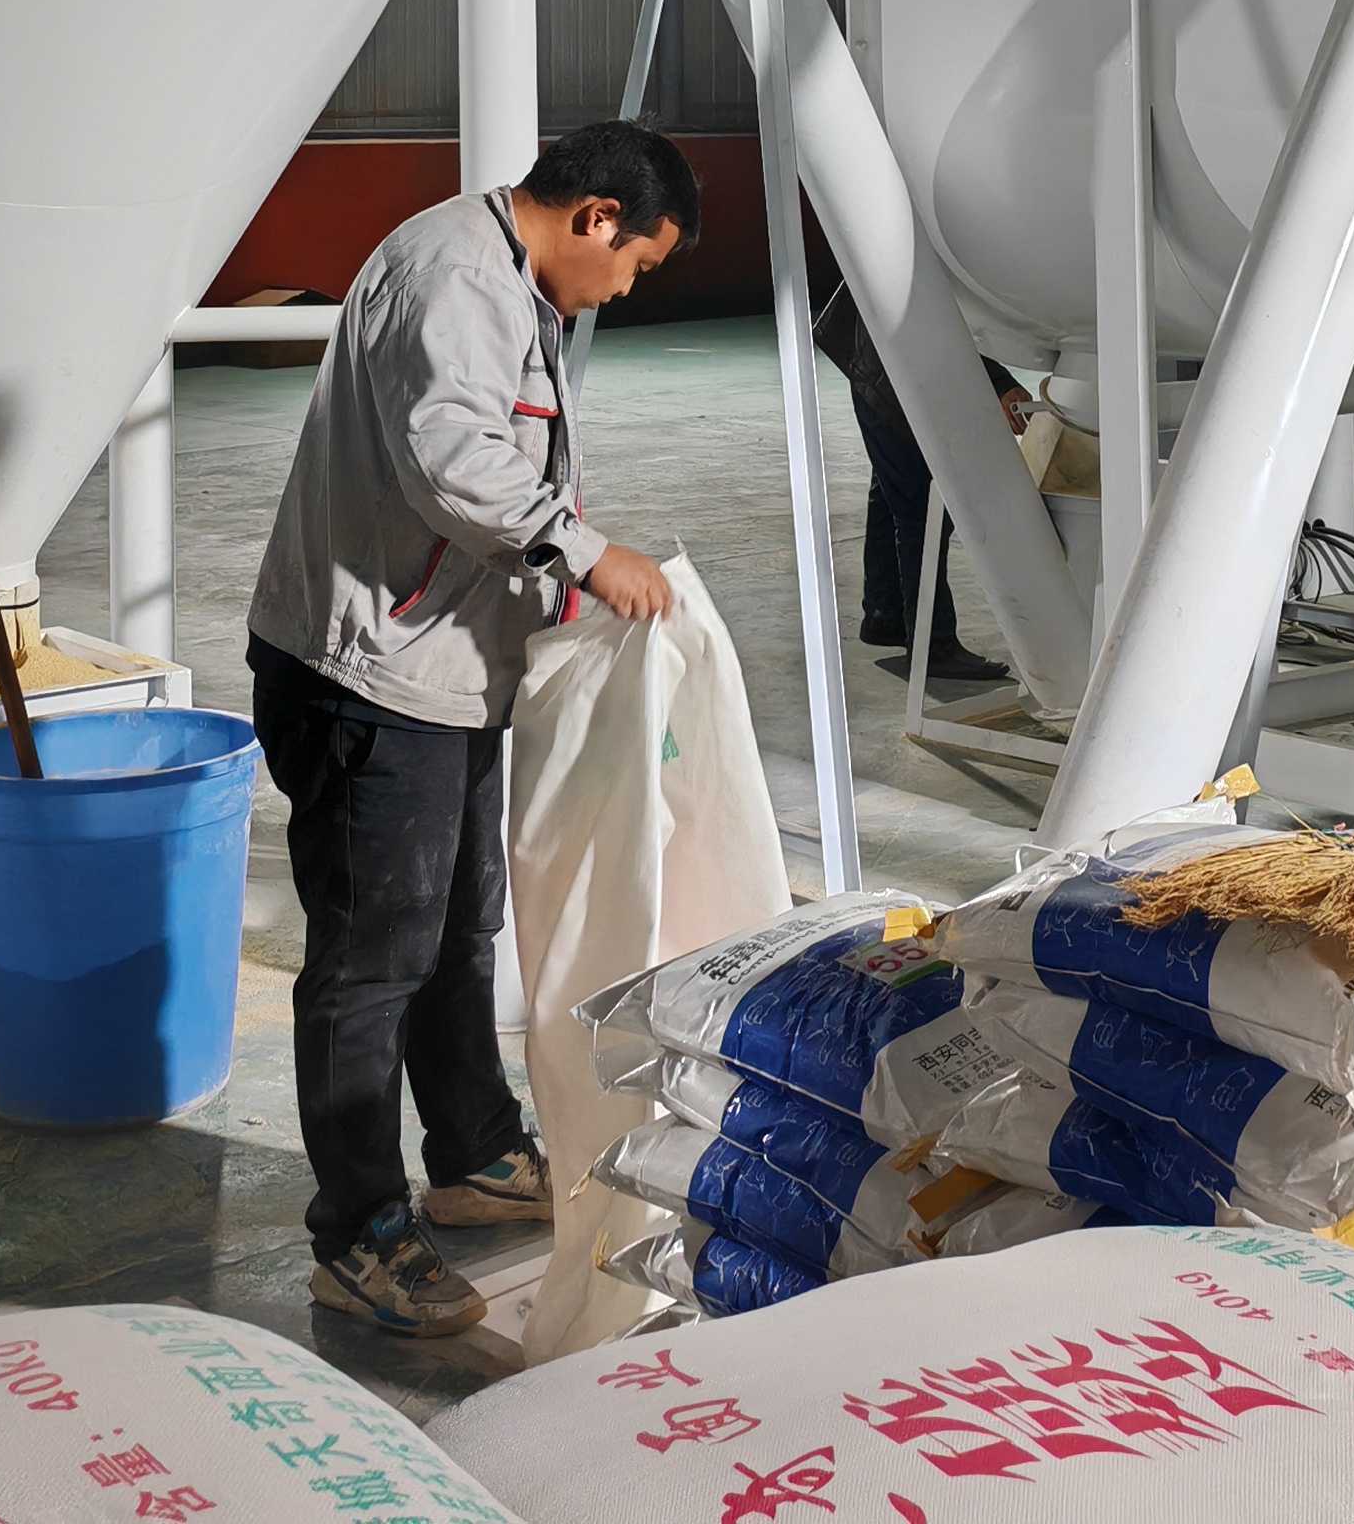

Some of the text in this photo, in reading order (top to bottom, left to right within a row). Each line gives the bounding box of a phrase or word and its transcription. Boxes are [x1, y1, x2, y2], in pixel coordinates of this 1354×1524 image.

[1174, 1271, 1275, 1323] 40kg
[597, 1348, 929, 1524] 奇面业
